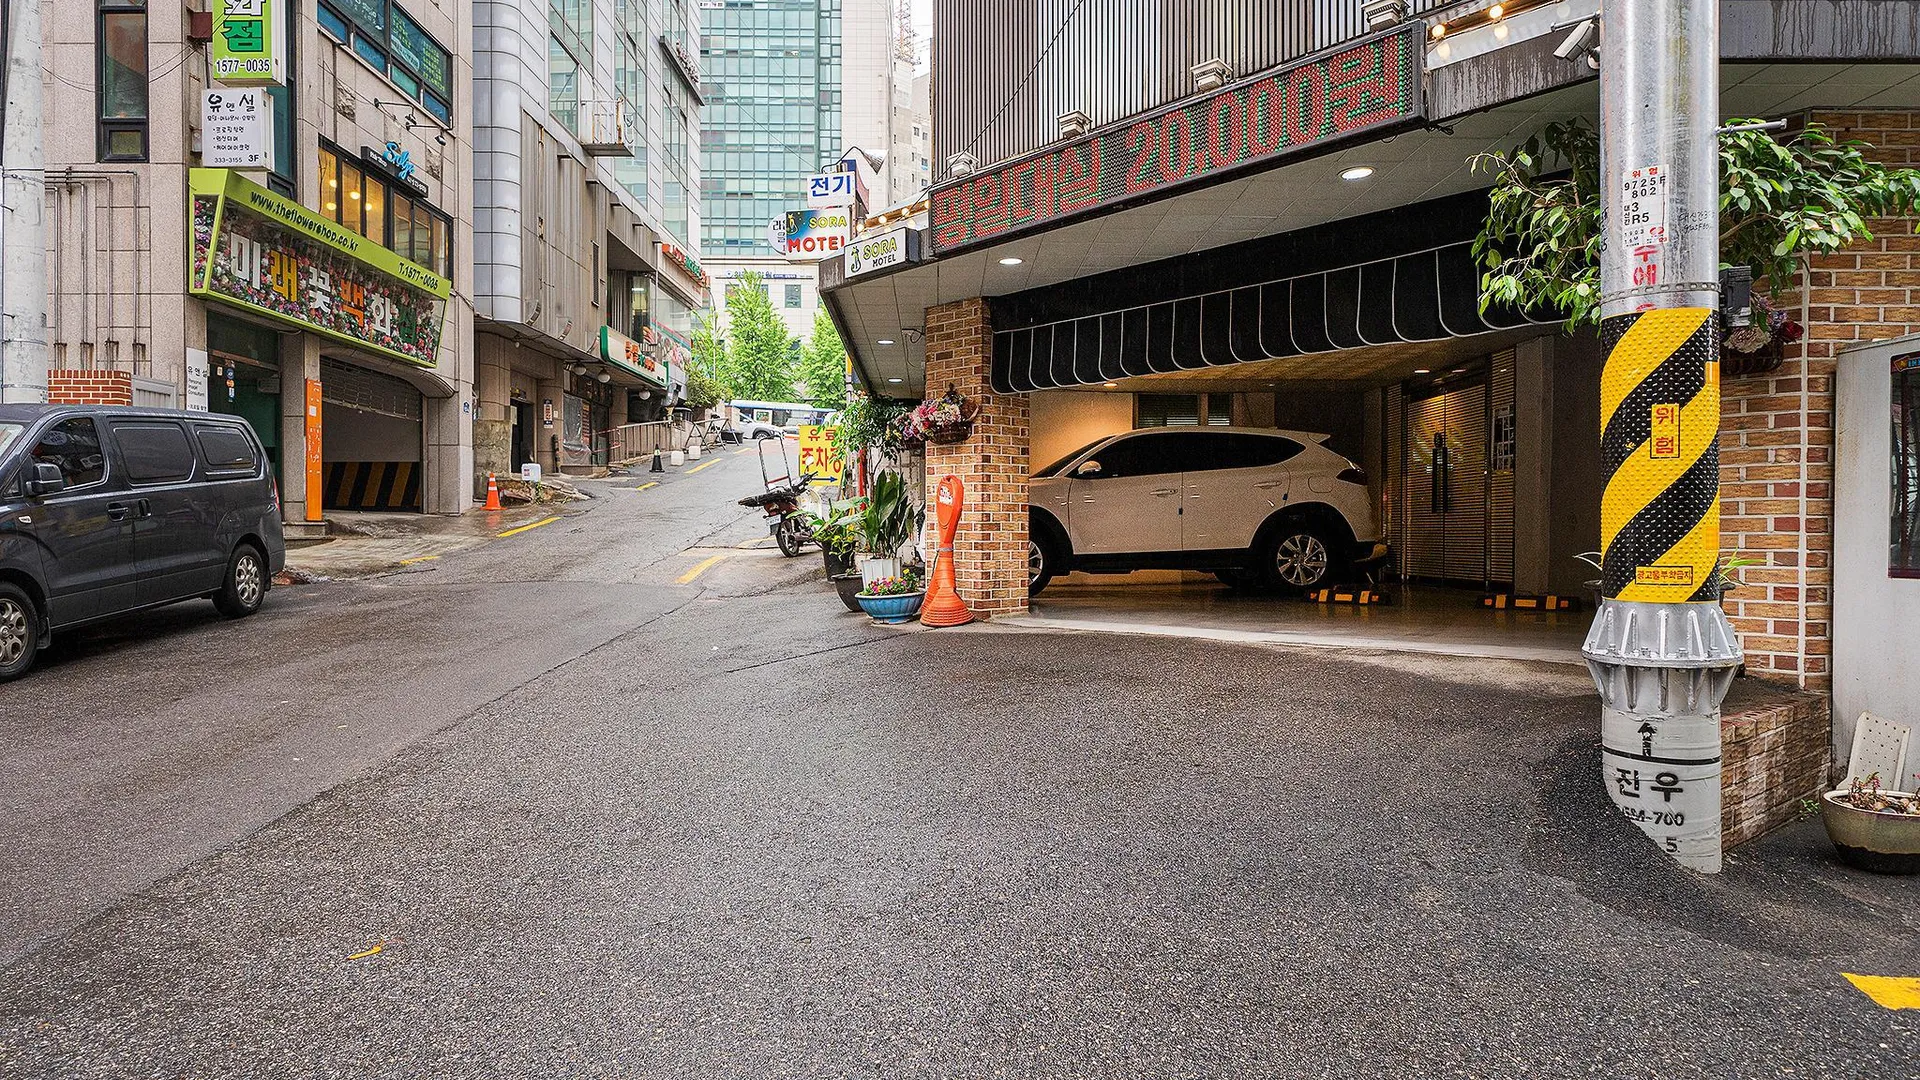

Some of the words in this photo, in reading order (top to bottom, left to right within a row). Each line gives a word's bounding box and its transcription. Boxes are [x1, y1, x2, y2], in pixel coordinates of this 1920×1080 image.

[216, 59, 270, 73] 1577-0035
[248, 154, 259, 163] 3F
[811, 175, 851, 197] 전기
[1632, 186, 1656, 199] 802
[1631, 202, 1639, 213] 3
[250, 191, 359, 253] www.theflowershop.co.kr
[808, 215, 848, 229] SORA
[1631, 212, 1650, 225] R5
[863, 237, 899, 261] SORA
[872, 253, 897, 268] MOTEL
[808, 428, 837, 441] 유료
[1655, 407, 1675, 454] 위험
